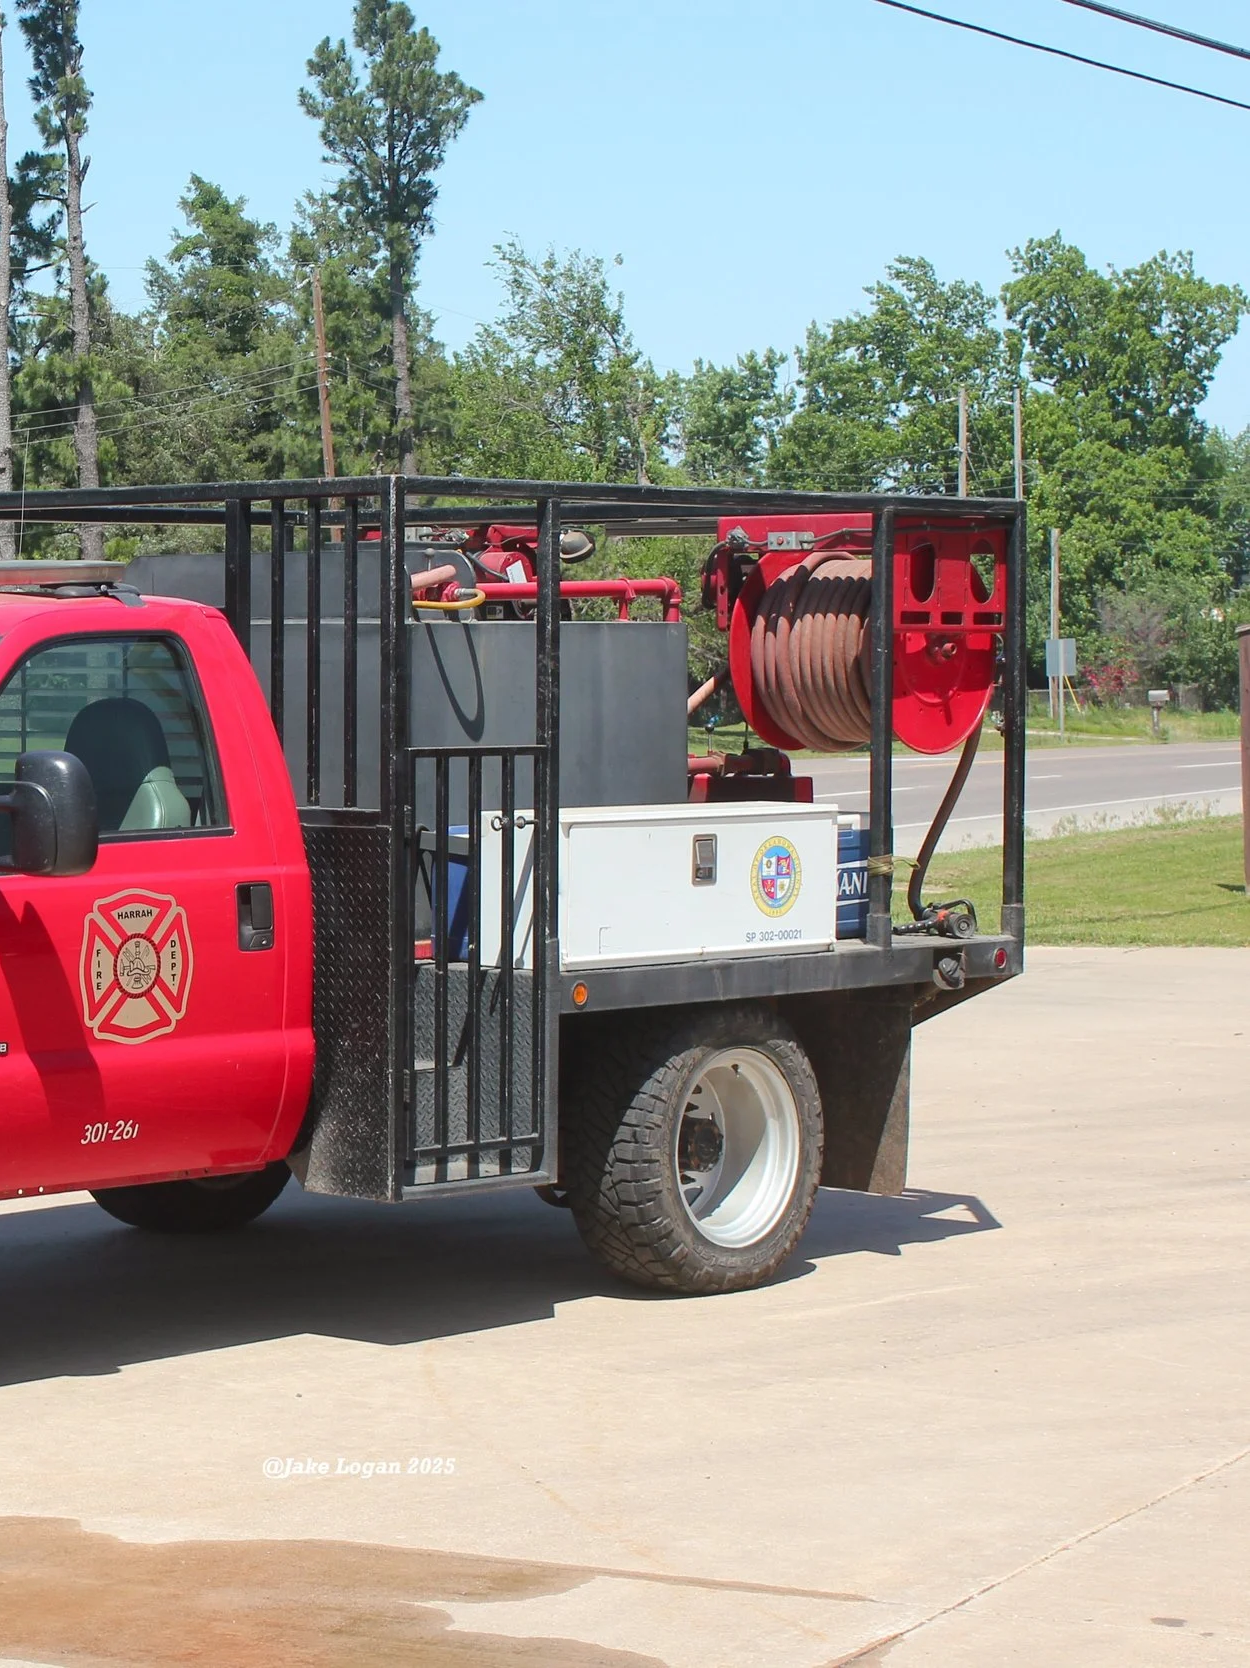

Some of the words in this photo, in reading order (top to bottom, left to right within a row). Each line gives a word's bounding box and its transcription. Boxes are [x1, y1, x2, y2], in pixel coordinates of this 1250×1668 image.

[117, 909, 153, 920] HARRAH
[745, 932, 757, 942] SP
[759, 929, 803, 941] 302-00021
[80, 1119, 139, 1145] 301-261
